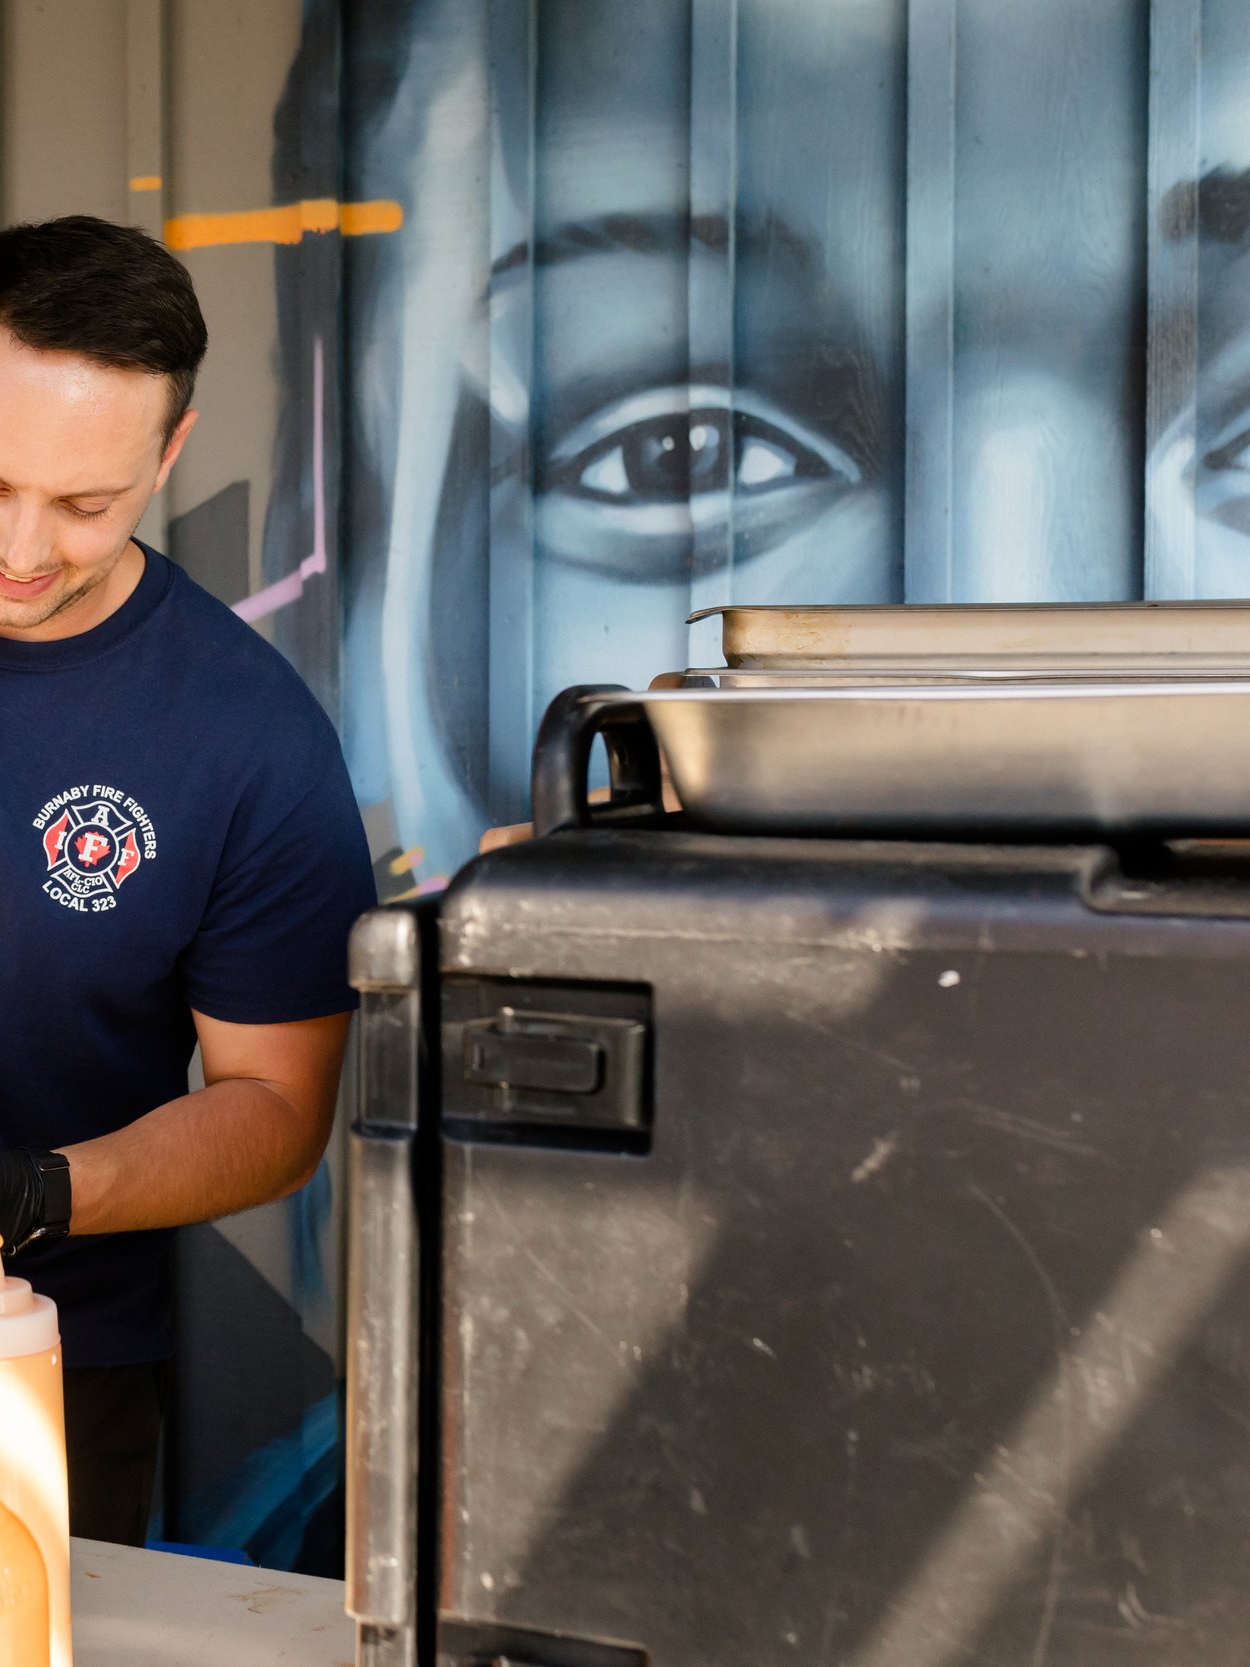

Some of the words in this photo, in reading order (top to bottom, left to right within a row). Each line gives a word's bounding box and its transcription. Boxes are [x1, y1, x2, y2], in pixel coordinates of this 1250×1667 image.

[32, 785, 90, 830] BURNABY
[92, 784, 125, 804] FIRE
[122, 797, 157, 860] FIGHTERS
[90, 805, 110, 827] A
[54, 831, 68, 850] I
[78, 833, 108, 862] F
[117, 848, 135, 866] F
[63, 868, 103, 886] AFL-CIO
[42, 880, 89, 912] LOCAL
[91, 895, 117, 912] 323
[70, 883, 91, 894] CLC
